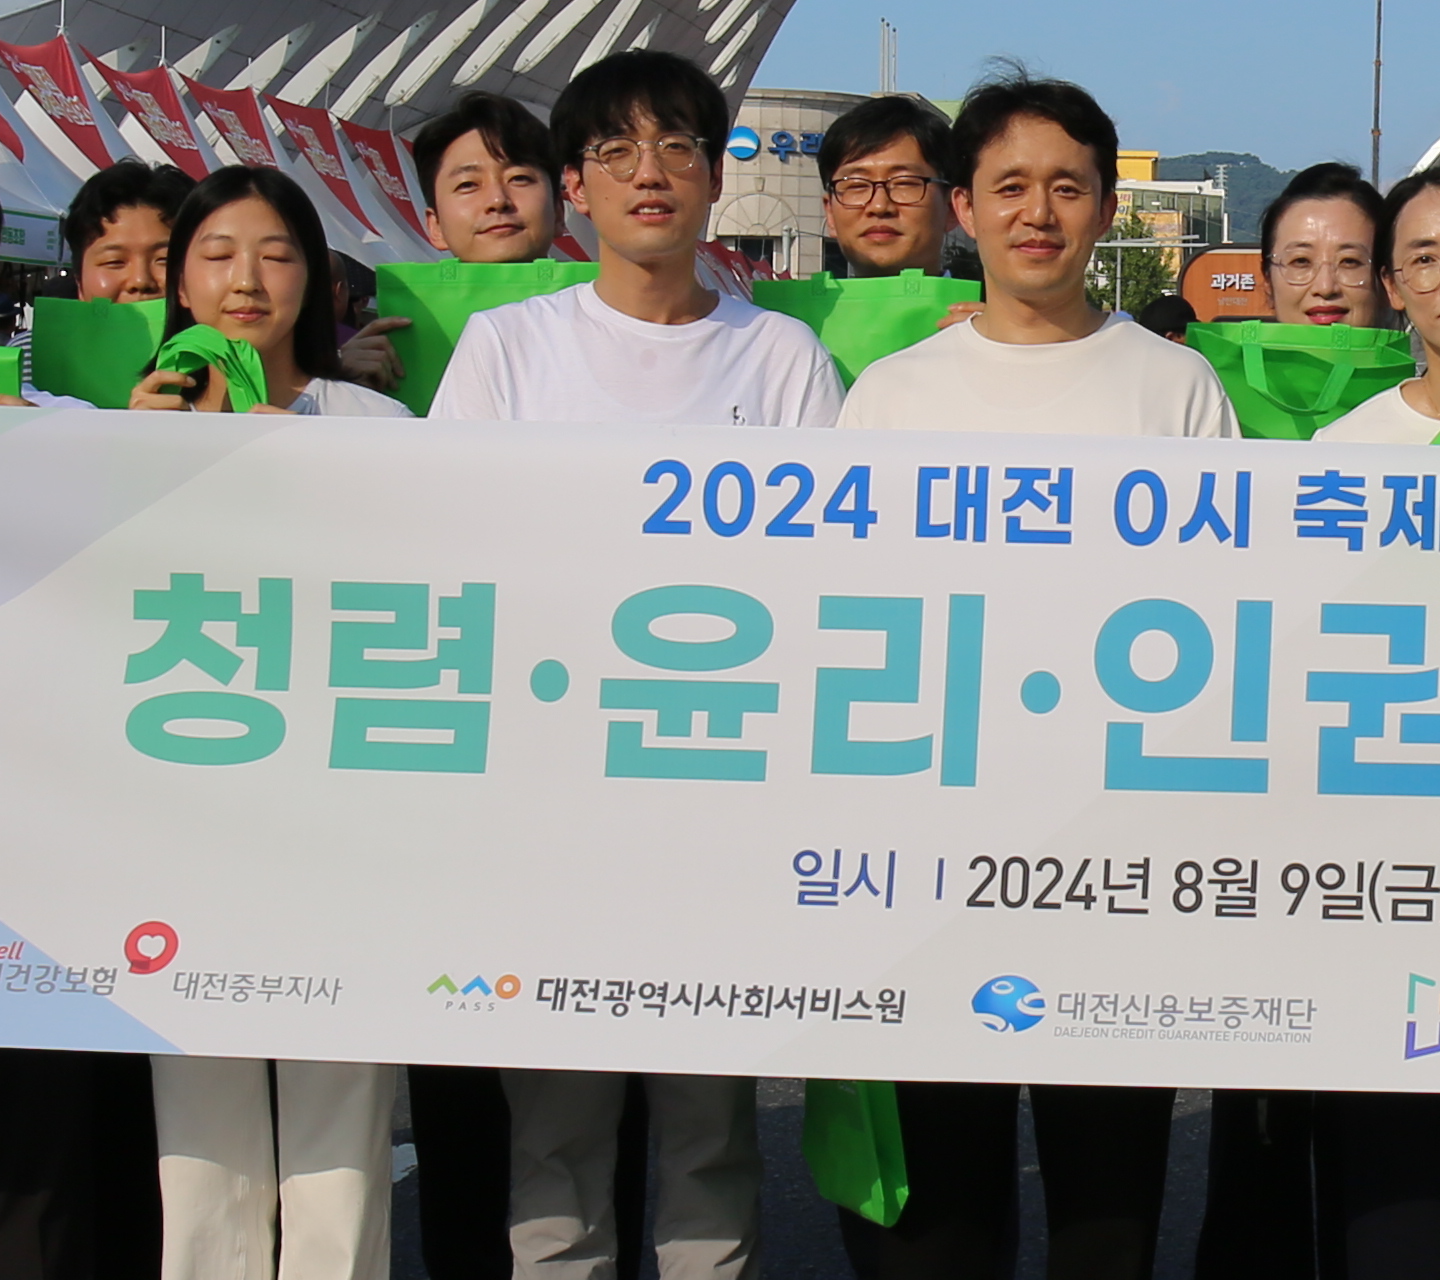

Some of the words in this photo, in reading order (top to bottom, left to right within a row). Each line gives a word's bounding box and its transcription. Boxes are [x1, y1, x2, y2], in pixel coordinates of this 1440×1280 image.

[1211, 273, 1256, 291] 과거존
[640, 458, 878, 540] 2024
[914, 463, 1074, 547] 대전
[1111, 467, 1253, 550] 0시
[791, 848, 898, 909] 일시
[965, 855, 1152, 916] 2024년
[1171, 856, 1259, 920] 8월
[171, 970, 344, 1006] 대전중부지사
[444, 1000, 497, 1013] PASS
[535, 976, 908, 1025] 대전광역시사회서비스원
[1056, 991, 1318, 1031] 대전신용보증재단
[1053, 1026, 1109, 1040] DAEJEON
[1112, 1028, 1155, 1041] CREDIT
[1157, 1029, 1230, 1043] GUARANTEE
[1233, 1030, 1312, 1044] FOUNDATION
